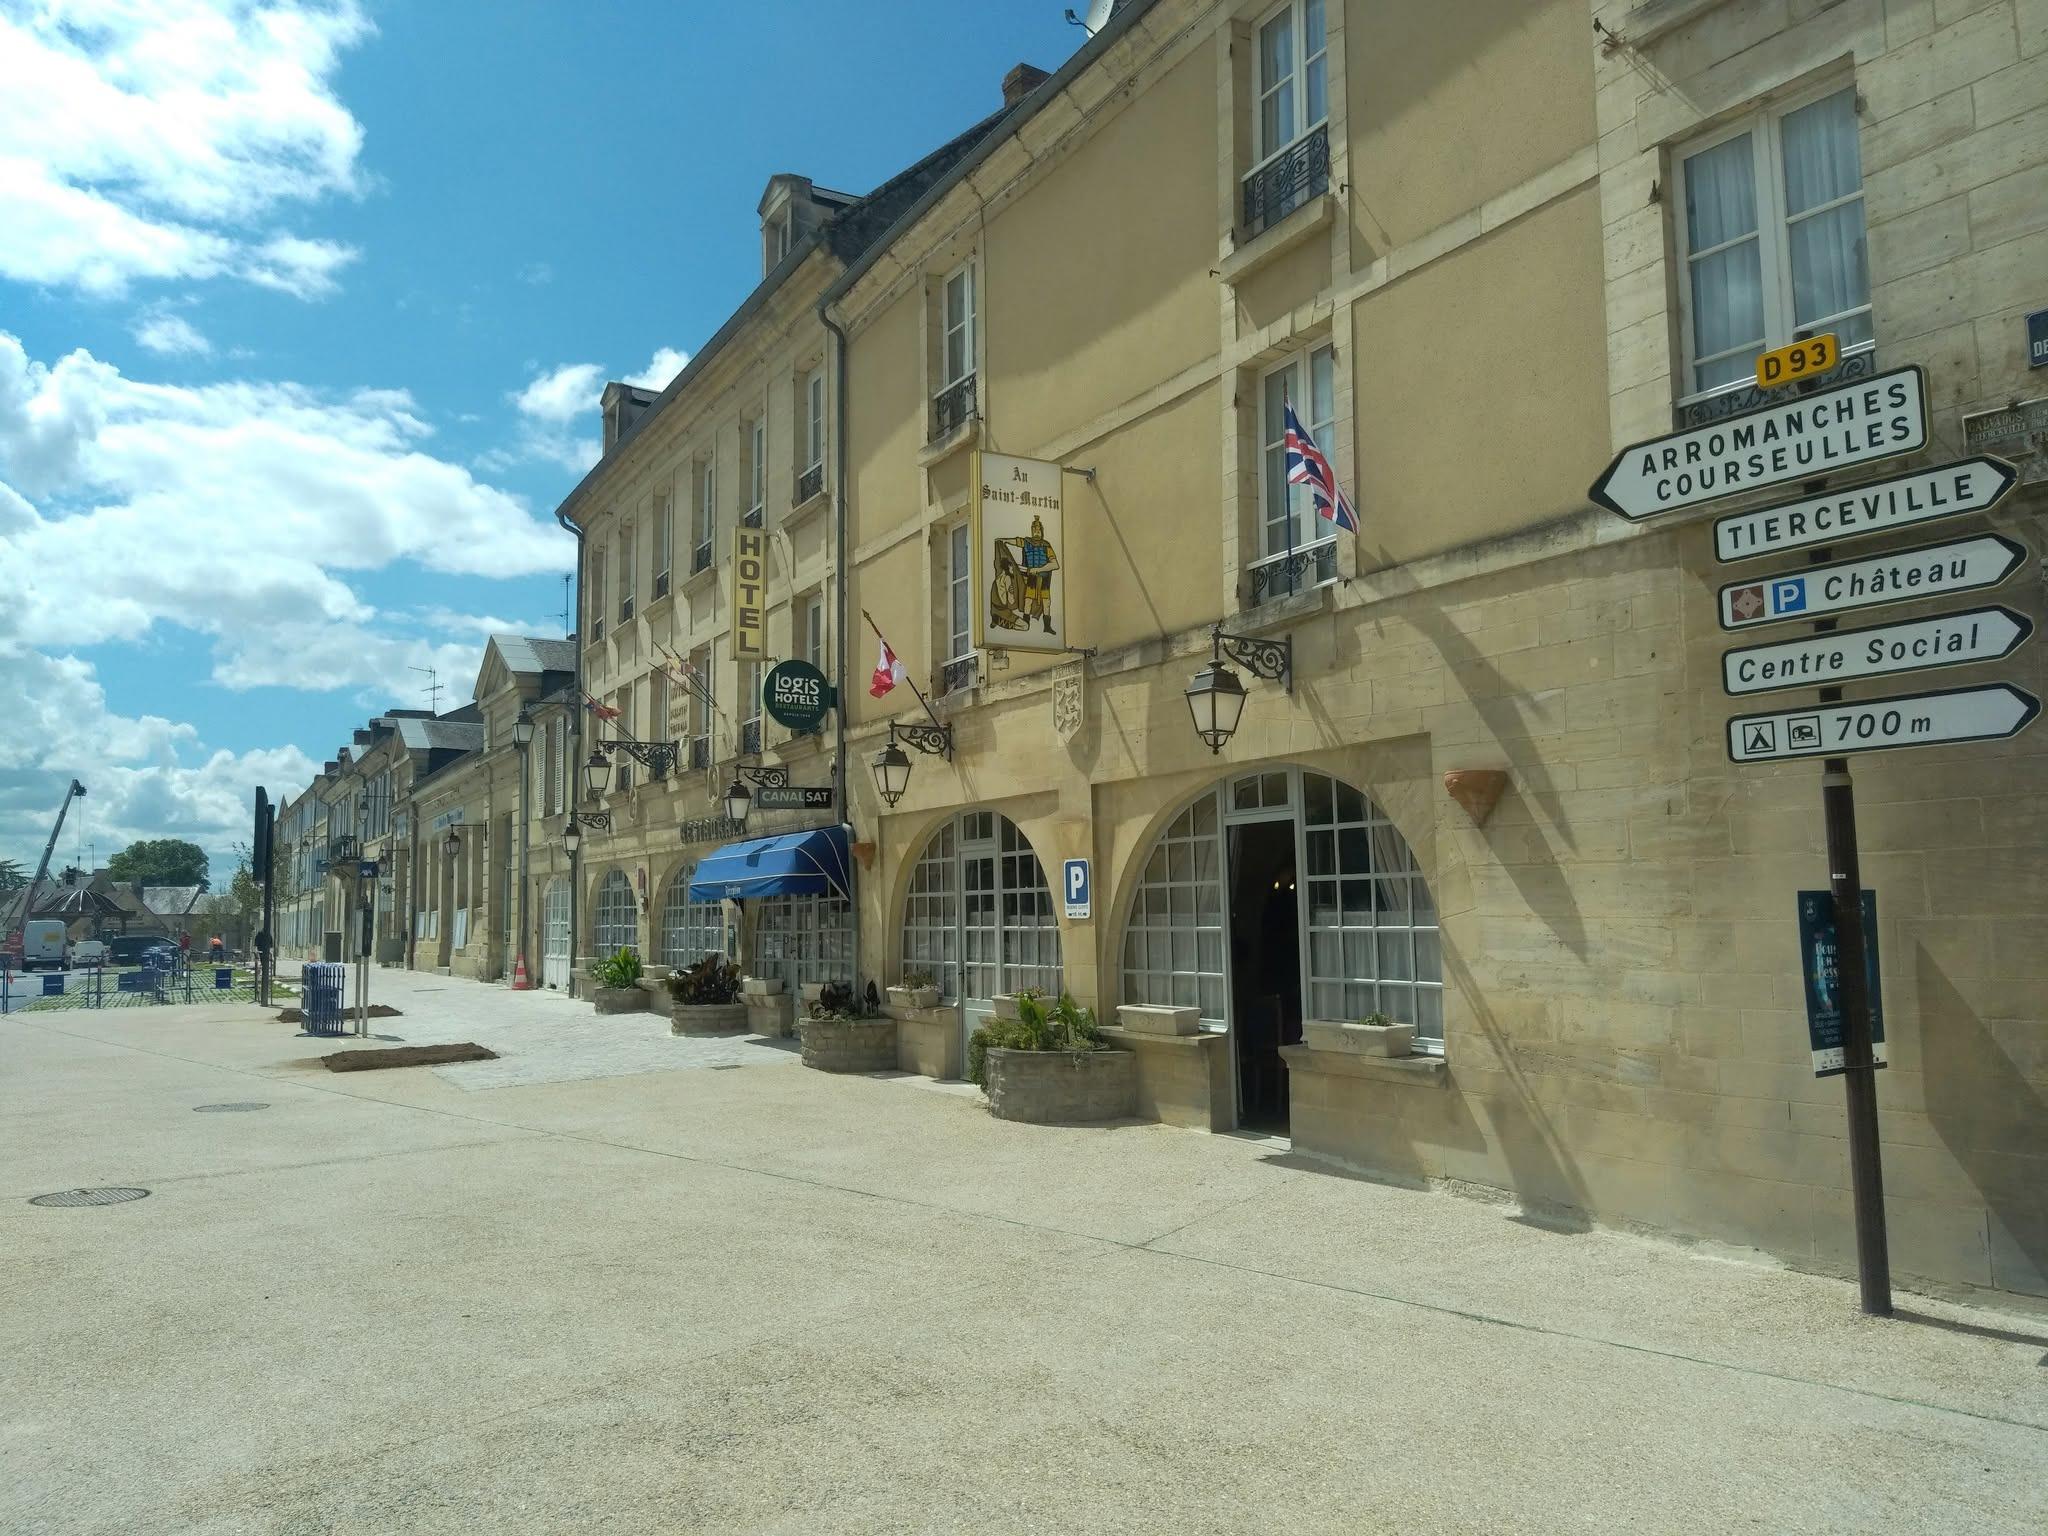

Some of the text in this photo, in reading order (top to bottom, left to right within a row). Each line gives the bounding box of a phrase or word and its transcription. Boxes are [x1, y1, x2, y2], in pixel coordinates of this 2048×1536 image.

[1641, 382, 1908, 477] ARROMANCHES
[1013, 466, 1028, 483] Au
[1656, 415, 1910, 501] COURSEULLES
[982, 484, 1060, 510] Saint-Martin
[1727, 474, 1974, 550] TIERCEVILLE
[739, 534, 761, 653] HOTEL
[1824, 556, 1967, 601] Château
[1738, 623, 1979, 683] Centre Social
[775, 692, 820, 706] HOTELS
[1836, 710, 1931, 741] 700 m
[1070, 866, 1085, 899] P
